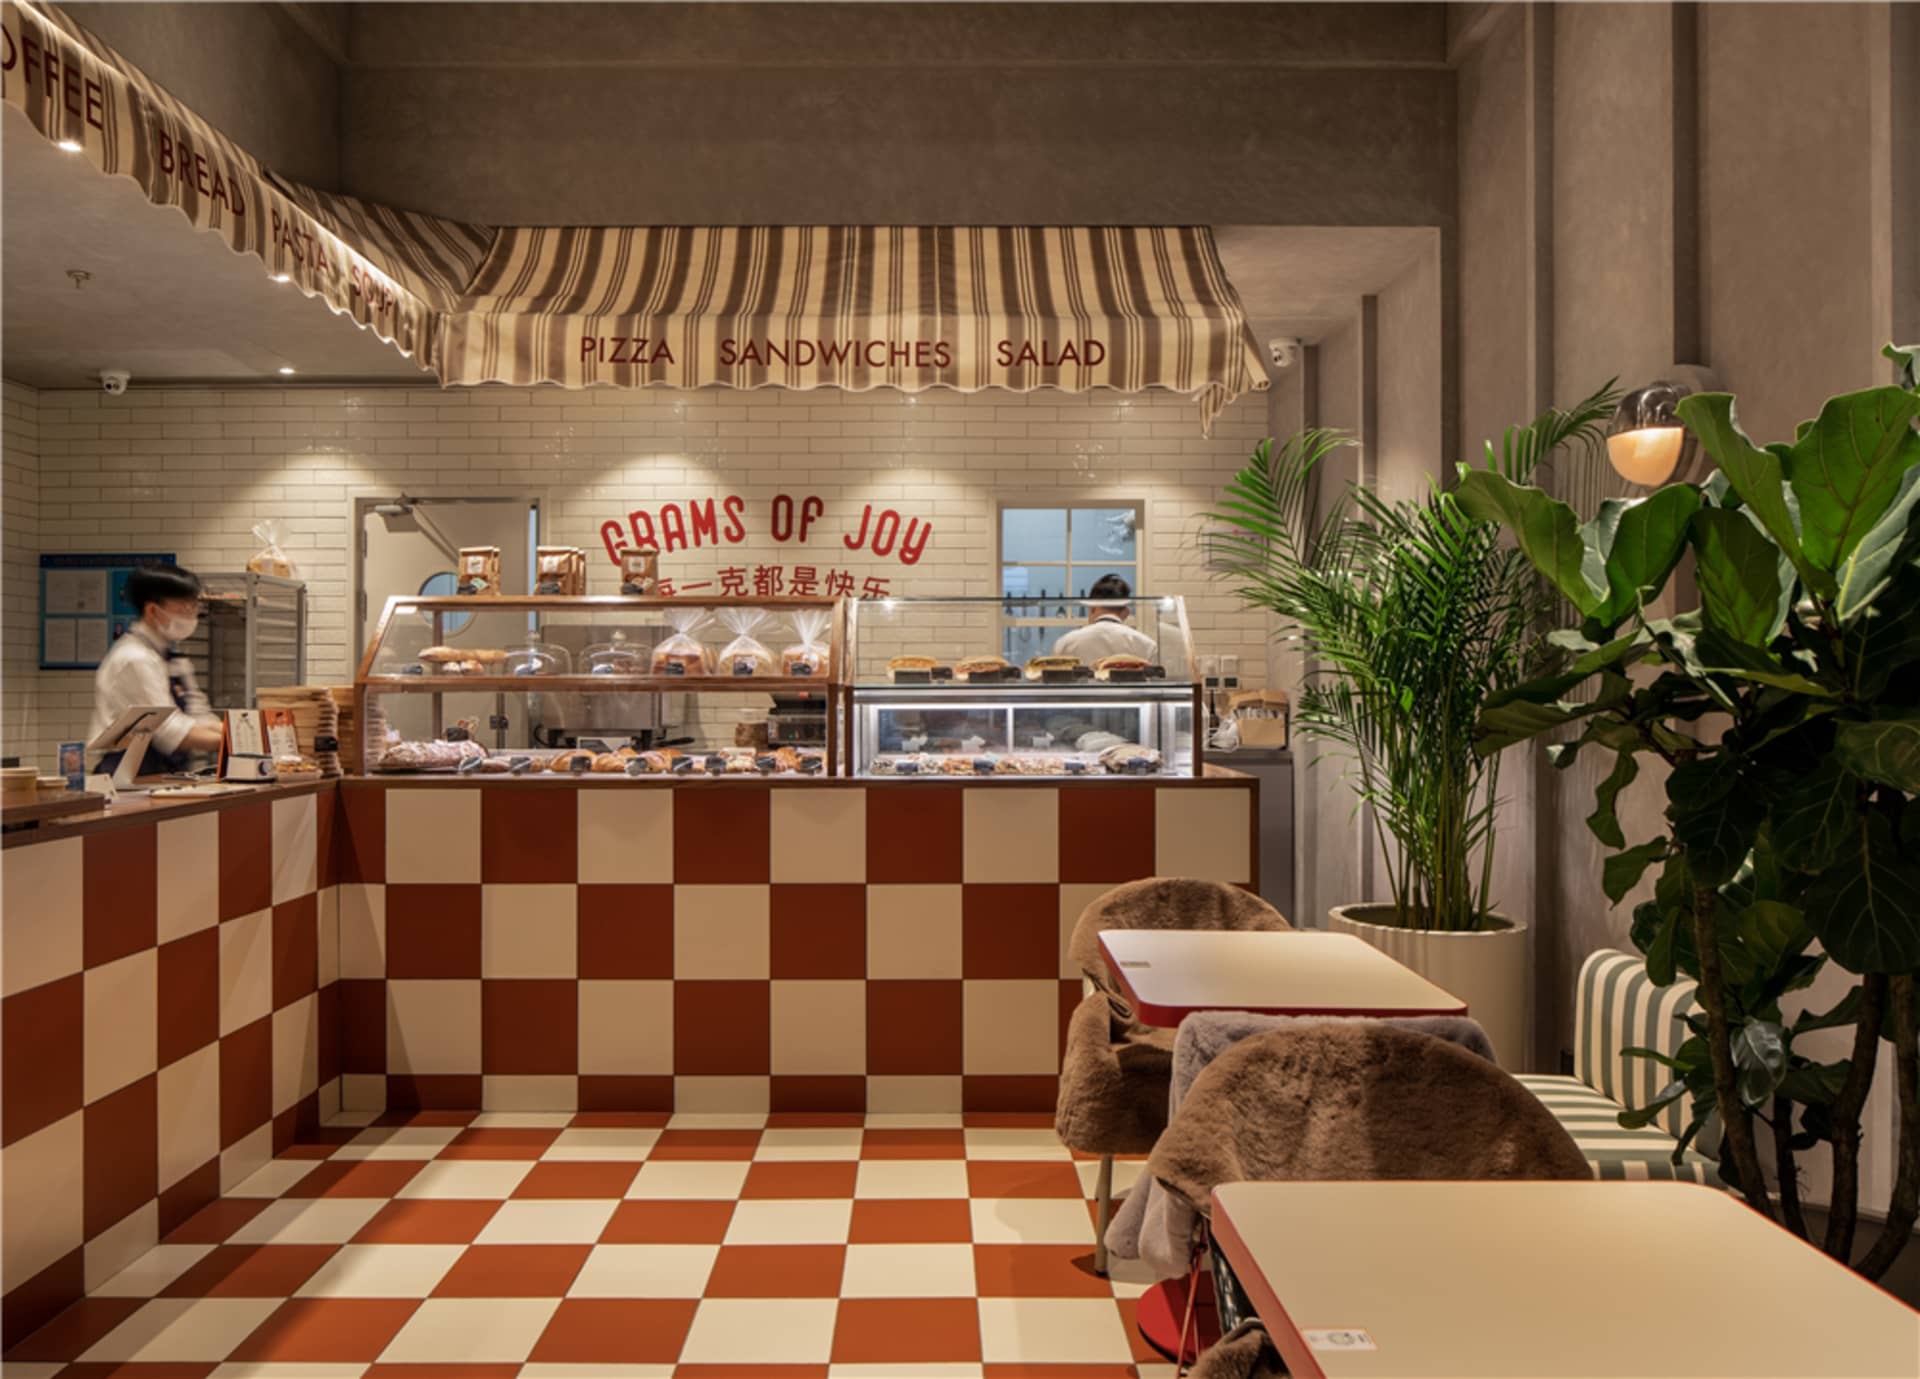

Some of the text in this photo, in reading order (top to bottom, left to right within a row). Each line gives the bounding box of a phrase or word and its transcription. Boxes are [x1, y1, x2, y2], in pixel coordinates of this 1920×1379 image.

[159, 129, 246, 217] BREAD
[271, 207, 329, 271] PASTA
[580, 335, 1106, 368] PIZZA SANDWICHES SALAD
[600, 494, 932, 567] GRAMS OF JOY
